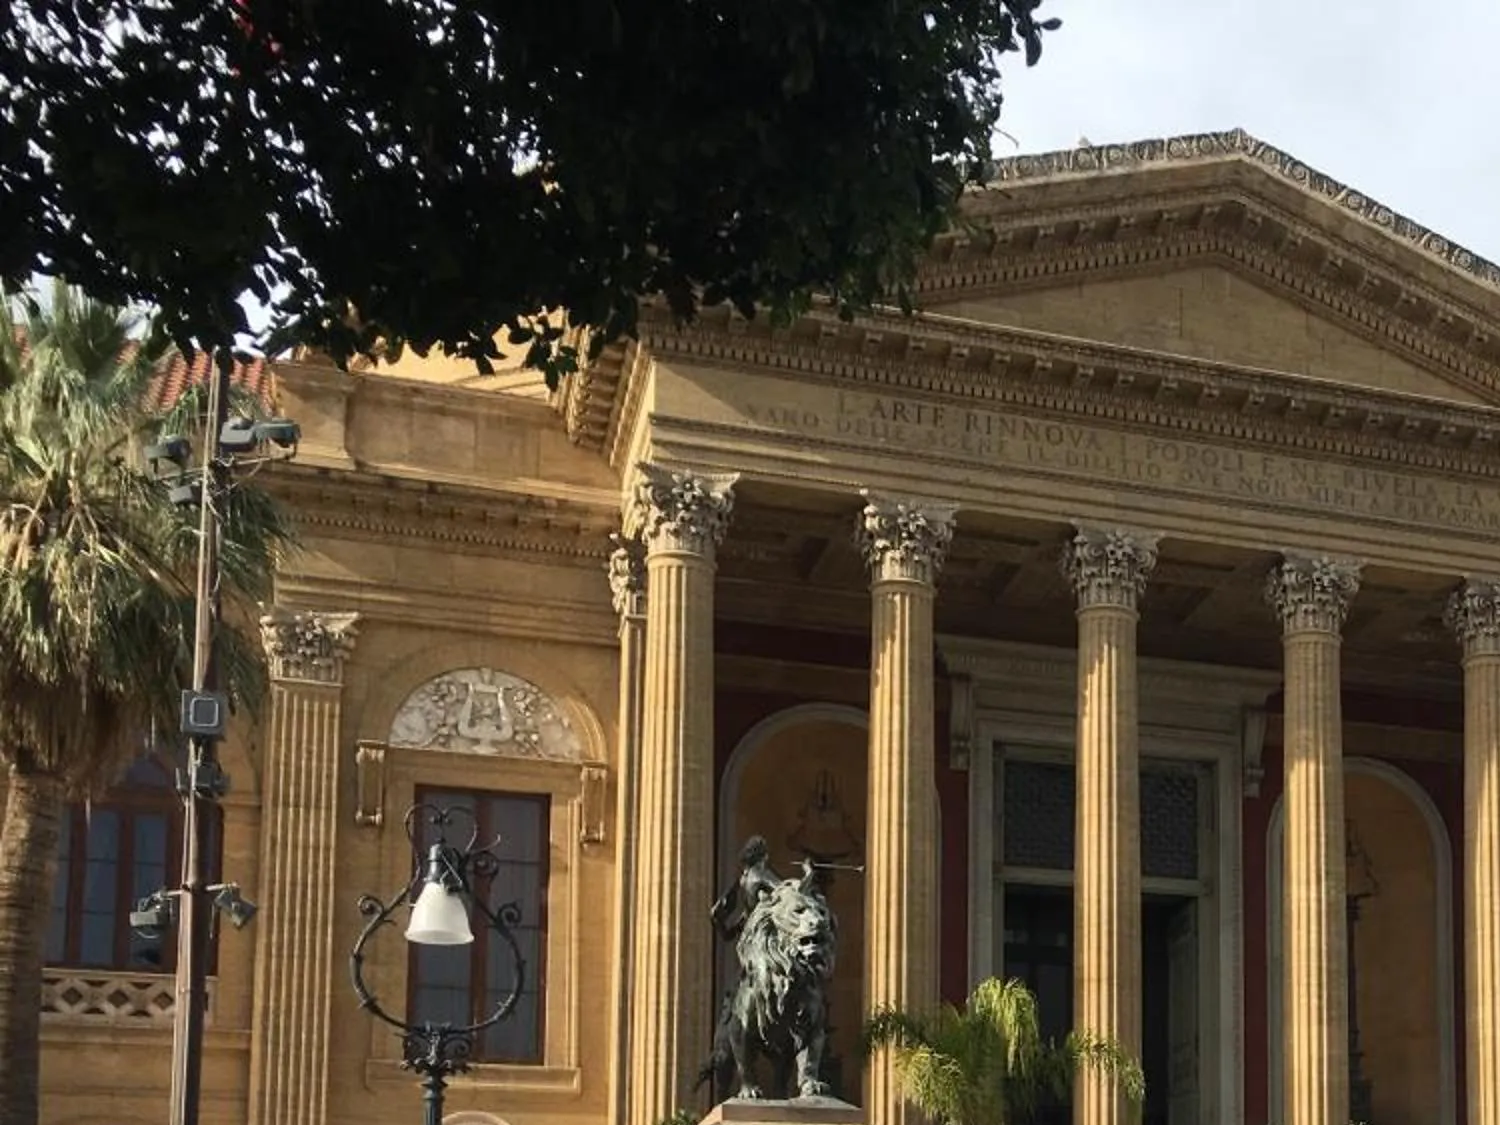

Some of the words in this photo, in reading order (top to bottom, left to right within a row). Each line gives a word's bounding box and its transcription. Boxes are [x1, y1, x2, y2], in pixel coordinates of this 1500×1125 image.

[869, 397, 945, 428] ARTE
[965, 411, 1102, 450] RINNOVA
[1146, 439, 1244, 471] POPOLI
[1343, 469, 1438, 502] RIVELA
[1456, 484, 1483, 509] LA
